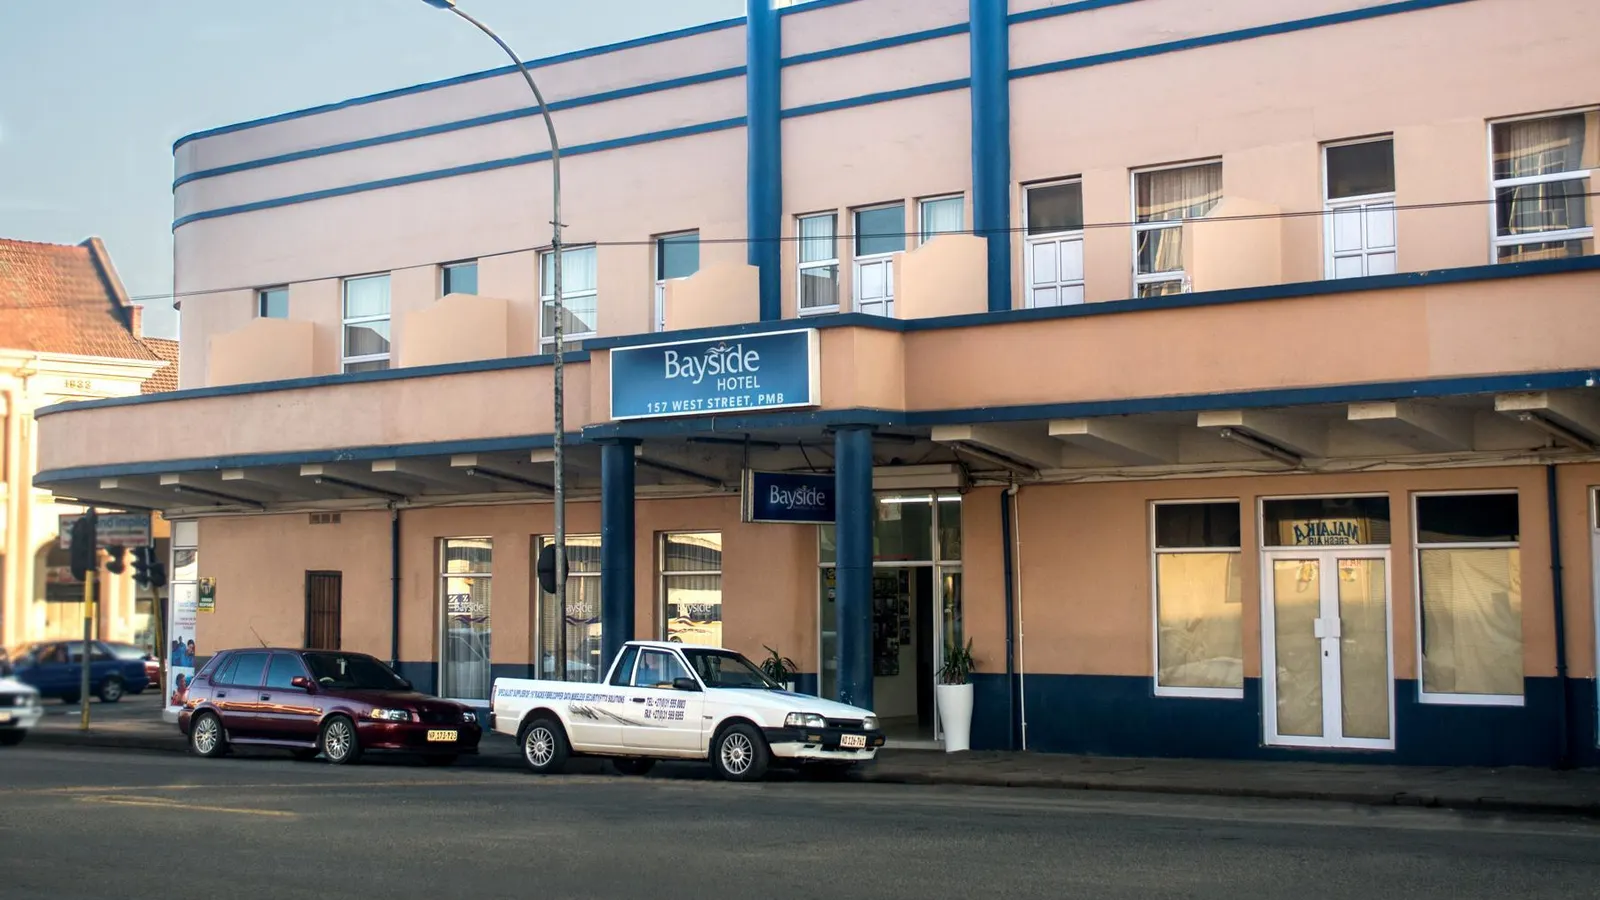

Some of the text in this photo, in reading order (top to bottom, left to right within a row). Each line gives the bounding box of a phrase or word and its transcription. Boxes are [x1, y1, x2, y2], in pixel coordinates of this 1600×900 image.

[664, 343, 760, 385] Bayside
[717, 376, 761, 392] HOTEL
[647, 392, 785, 414] 157 WEST STREET, PMB
[769, 484, 826, 510] Bayside
[565, 602, 593, 614] ayside
